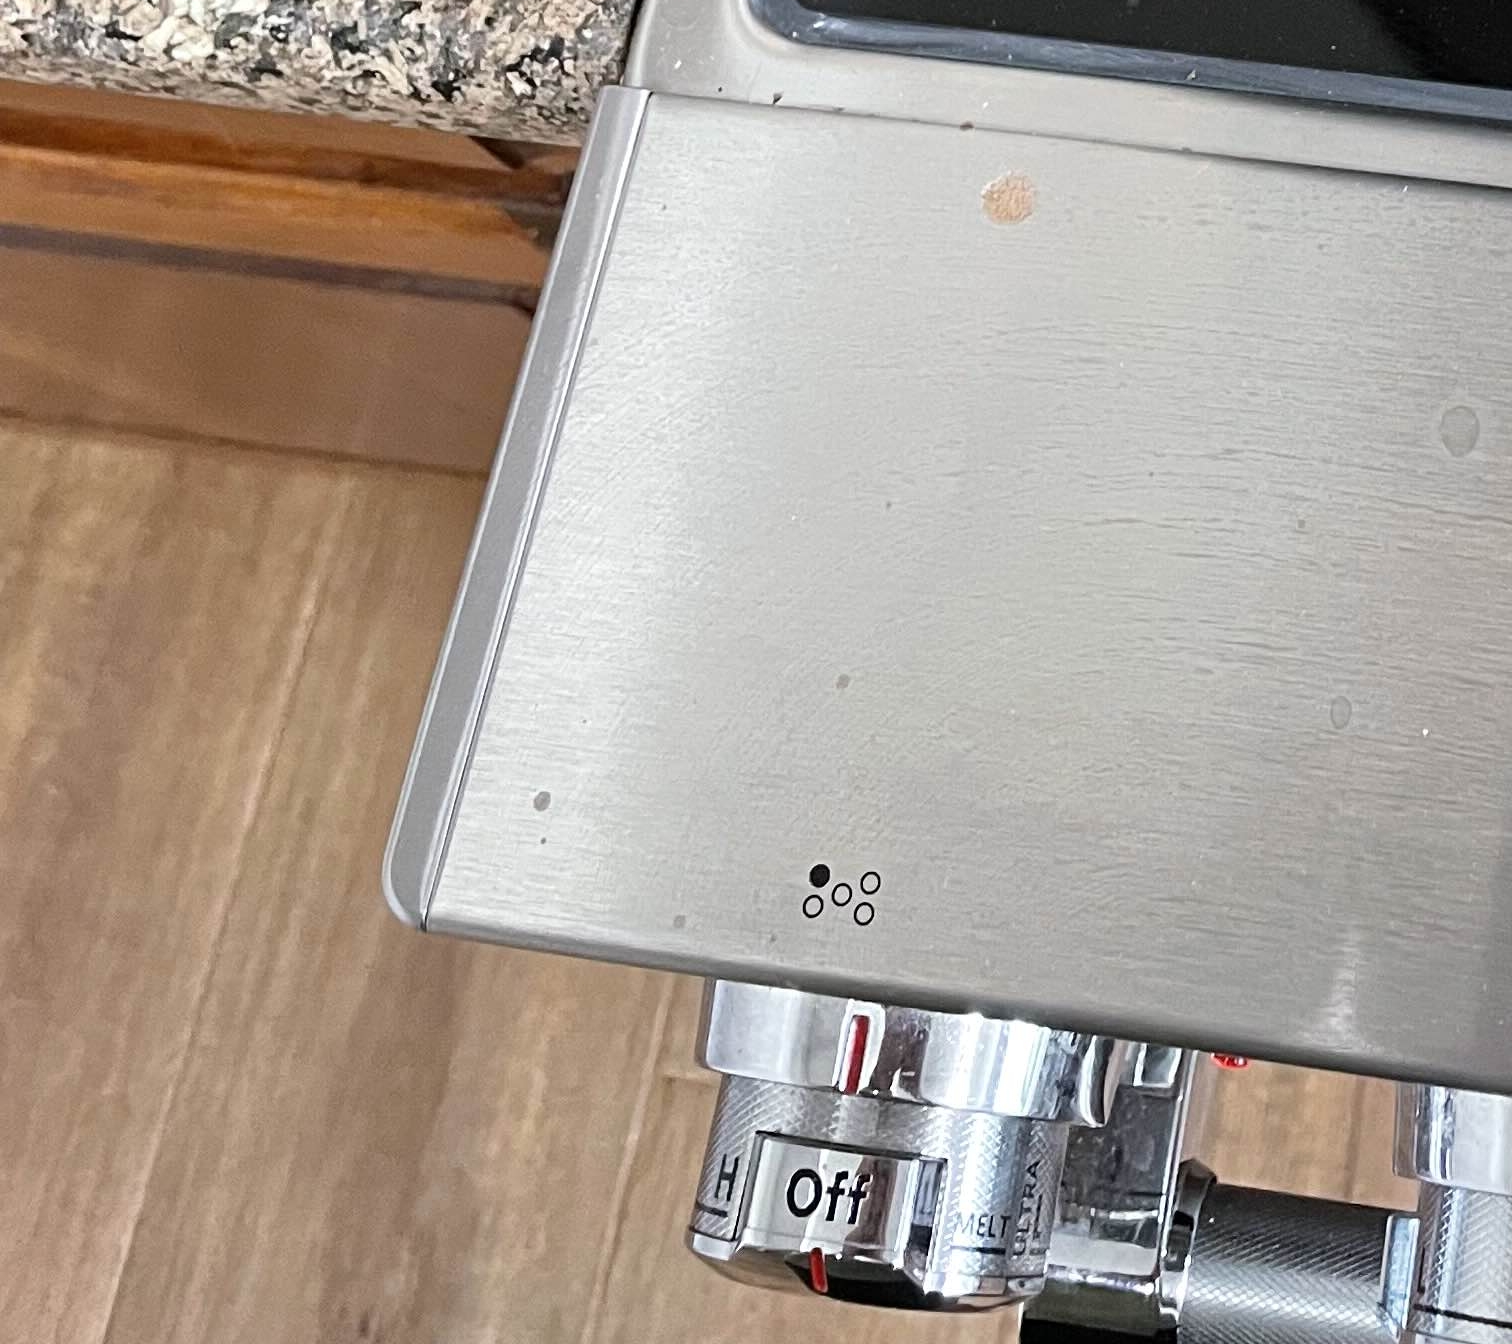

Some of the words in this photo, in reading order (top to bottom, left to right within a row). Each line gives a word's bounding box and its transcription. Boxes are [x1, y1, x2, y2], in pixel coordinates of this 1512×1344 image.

[714, 1154, 739, 1202] H
[786, 1168, 871, 1225] Off
[953, 1215, 1010, 1239] MELT
